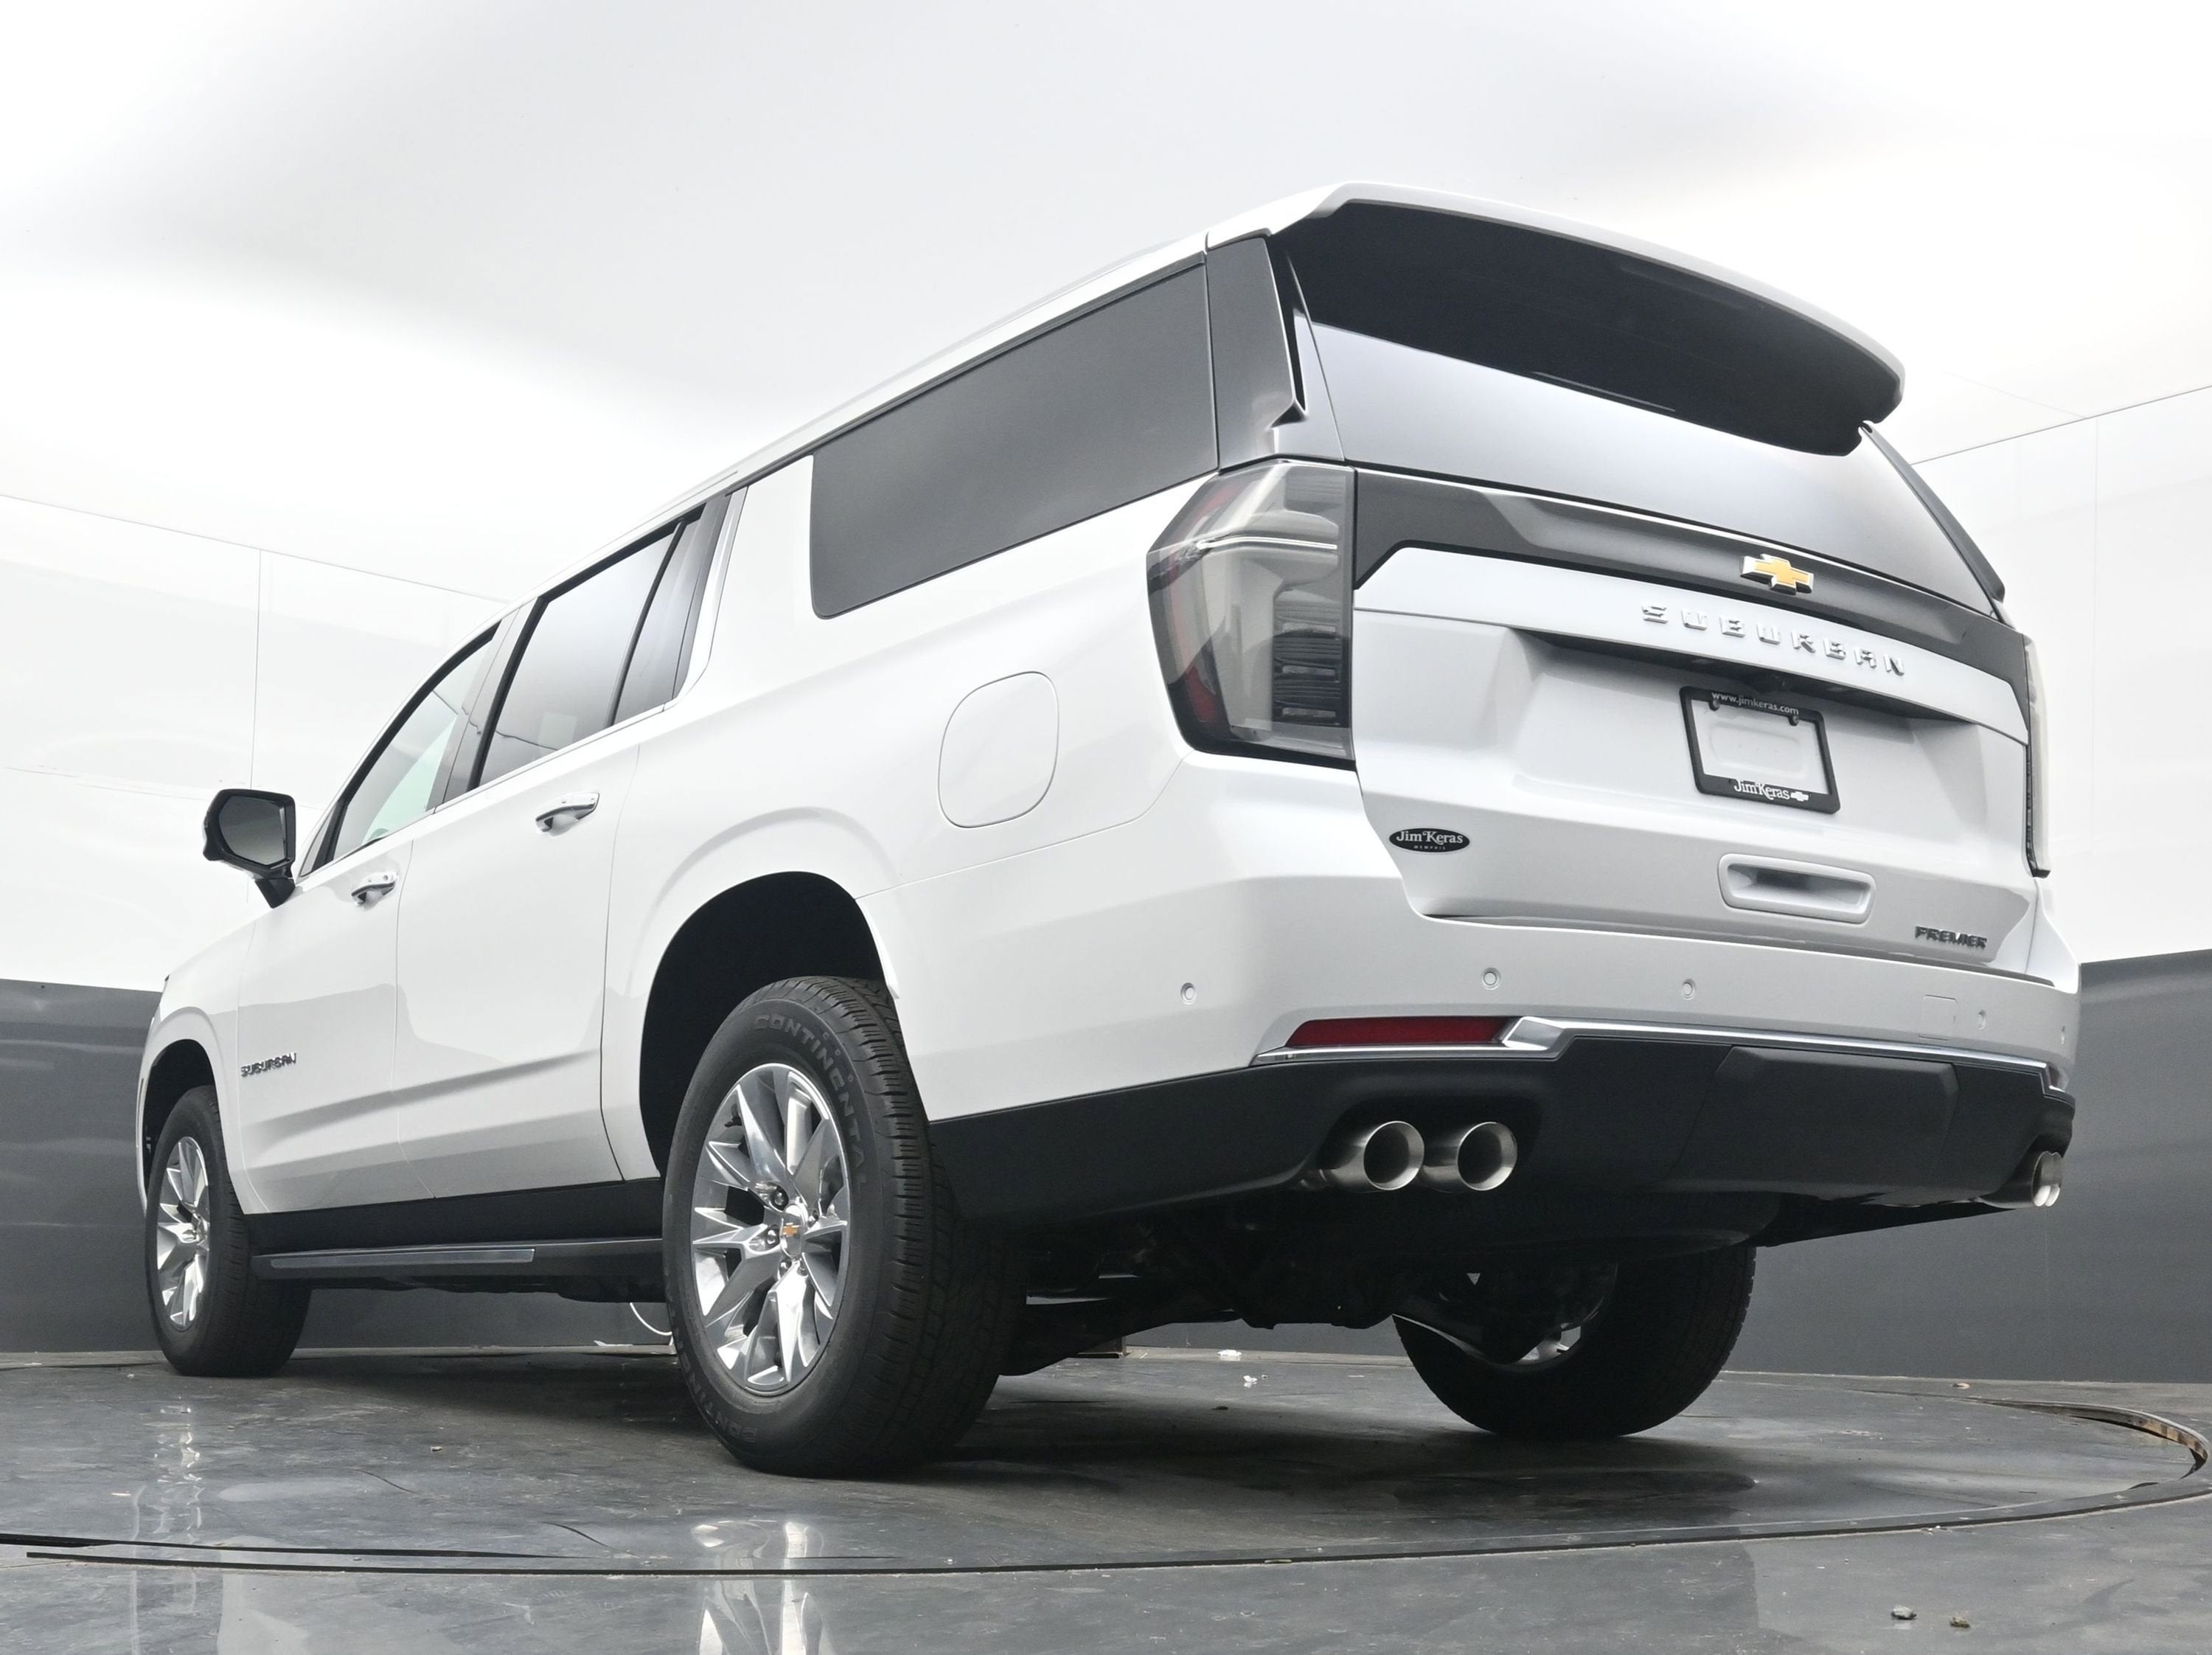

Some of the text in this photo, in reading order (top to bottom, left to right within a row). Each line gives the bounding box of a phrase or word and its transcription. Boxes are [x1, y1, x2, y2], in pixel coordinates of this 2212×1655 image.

[1641, 602, 1905, 676] SUBURBAN
[1711, 693, 1799, 715] www.jimkeras.com
[1422, 830, 1463, 845] Keras
[1915, 926, 1987, 949] PREMIER
[754, 1013, 868, 1193] CONTINENTAL
